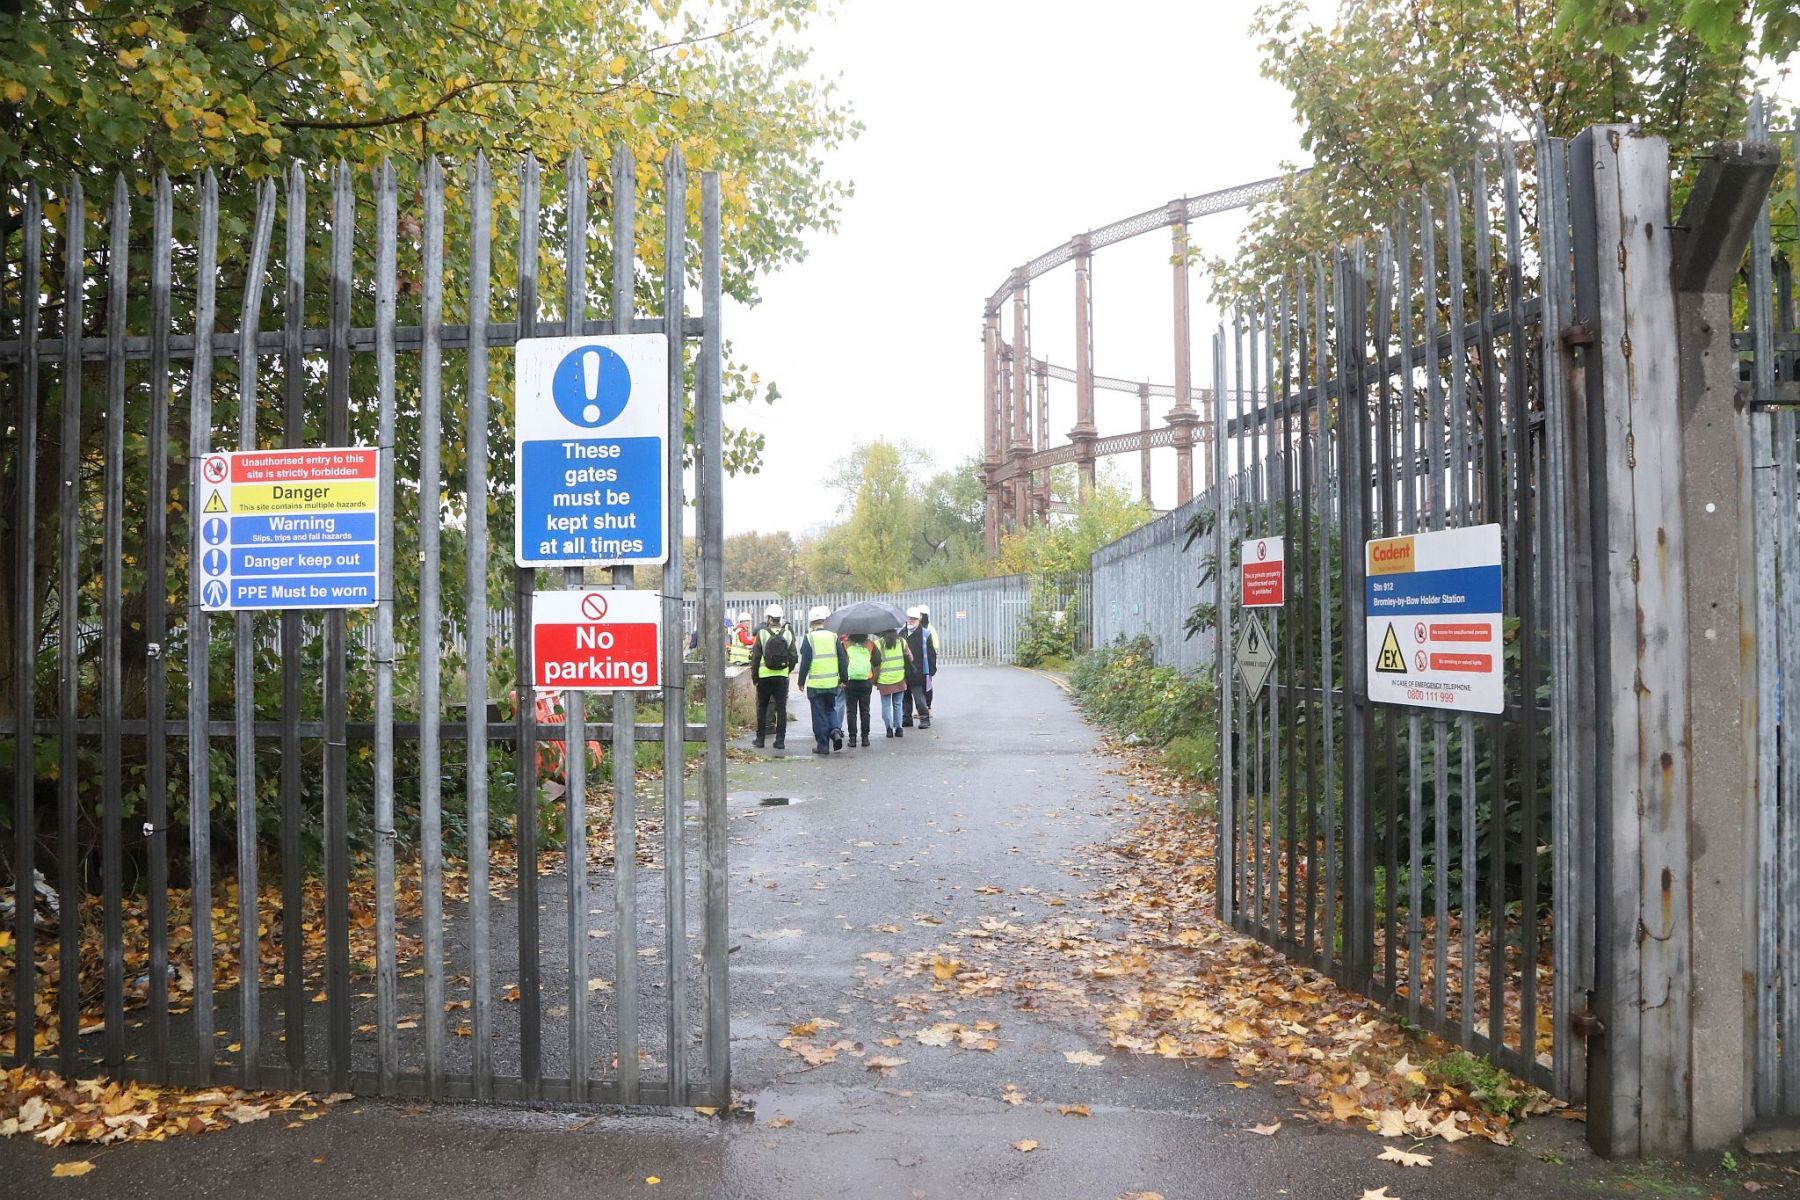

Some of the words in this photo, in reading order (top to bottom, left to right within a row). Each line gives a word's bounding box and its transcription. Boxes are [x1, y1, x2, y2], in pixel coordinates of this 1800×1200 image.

[562, 443, 621, 459] These
[242, 456, 304, 467] Unauthorised
[306, 457, 331, 466] entry
[346, 454, 364, 463] this
[247, 470, 263, 479] site
[266, 470, 274, 478] is
[276, 468, 309, 479] strictly
[312, 467, 358, 477] forbidden
[565, 466, 618, 486] gates
[273, 486, 330, 502] Danger
[554, 490, 601, 507] must
[606, 489, 630, 505] be
[304, 502, 334, 510] multiple
[269, 516, 335, 532] Warning
[547, 514, 588, 534] kept
[594, 513, 636, 530] shut
[252, 534, 272, 542] Slips,
[274, 534, 290, 542] trips
[322, 532, 352, 540] hazards
[540, 538, 558, 554] at
[562, 537, 585, 554] all
[590, 536, 643, 553] times
[1373, 543, 1410, 562] Cadent
[244, 556, 294, 570] Danger
[298, 554, 332, 568] keep
[336, 553, 360, 566] out
[238, 586, 268, 599] PPE
[272, 586, 306, 598] Must
[310, 586, 328, 598] be
[332, 586, 368, 597] worn
[1374, 583, 1382, 592] Stn
[1384, 582, 1394, 591] 912
[1374, 596, 1420, 608] Bromley-by-Bow
[1420, 595, 1440, 604] Holder
[1442, 594, 1465, 604] Station
[576, 626, 614, 650] No
[1384, 650, 1398, 668] EX
[544, 656, 648, 684] parking
[1415, 681, 1442, 689] EMERGENCY
[1407, 689, 1424, 700] 0800
[1426, 692, 1438, 702] 111
[1440, 692, 1454, 703] 999
